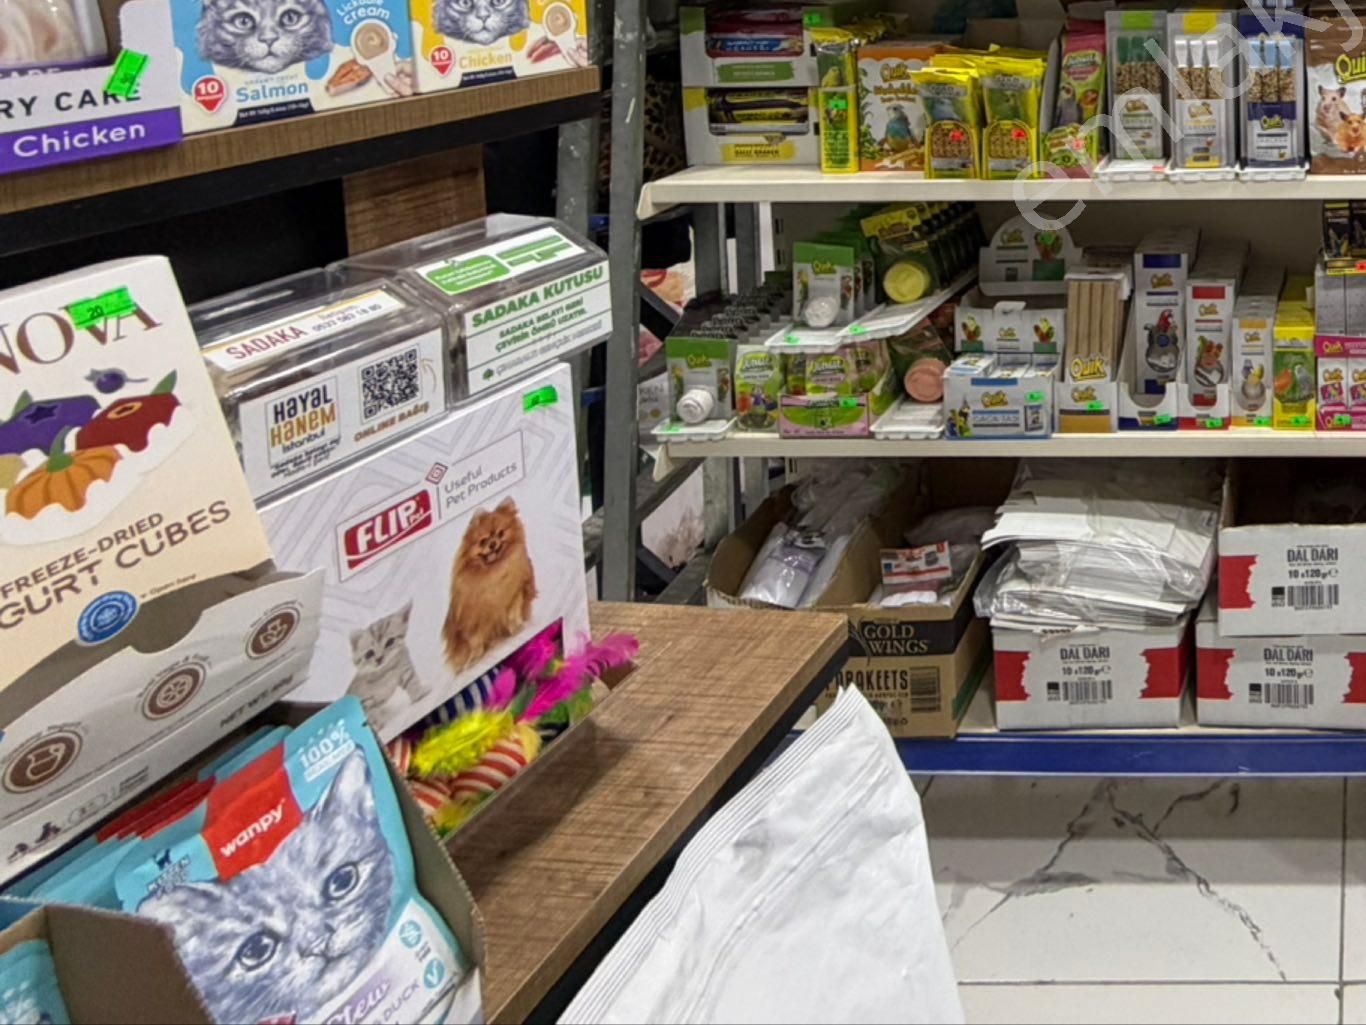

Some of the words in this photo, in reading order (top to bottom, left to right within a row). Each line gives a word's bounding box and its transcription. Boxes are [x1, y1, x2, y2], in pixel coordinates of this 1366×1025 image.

[343, 7, 390, 25] cream
[432, 50, 447, 61] 10
[459, 51, 513, 69] Chicken
[198, 82, 218, 96] 10
[236, 82, 309, 103] Salmon
[13, 123, 146, 157] Chicken
[472, 290, 540, 328] SADAKA
[543, 266, 603, 300] KUTUSU
[226, 326, 307, 360] SADAKA
[445, 466, 482, 494] Useful
[446, 492, 465, 509] Pet
[468, 463, 518, 497] Products
[116, 500, 231, 569] CUBES
[357, 500, 418, 555] FLIP
[1, 513, 164, 599] FREEZE-DRIED
[1287, 548, 1309, 562] DAL
[1311, 547, 1338, 561] DARI
[1288, 569, 1300, 579] 10
[864, 625, 915, 639] GOLD
[868, 639, 929, 654] WINGS
[1060, 648, 1080, 660] DAL
[1083, 646, 1110, 659] DARI
[1264, 648, 1285, 661] DAL
[1287, 648, 1313, 662] DARI
[1062, 666, 1073, 676] 10
[1265, 668, 1276, 677] 10
[299, 725, 350, 770] 100%
[220, 804, 285, 856] wanpy
[382, 981, 420, 1021] DUCK
